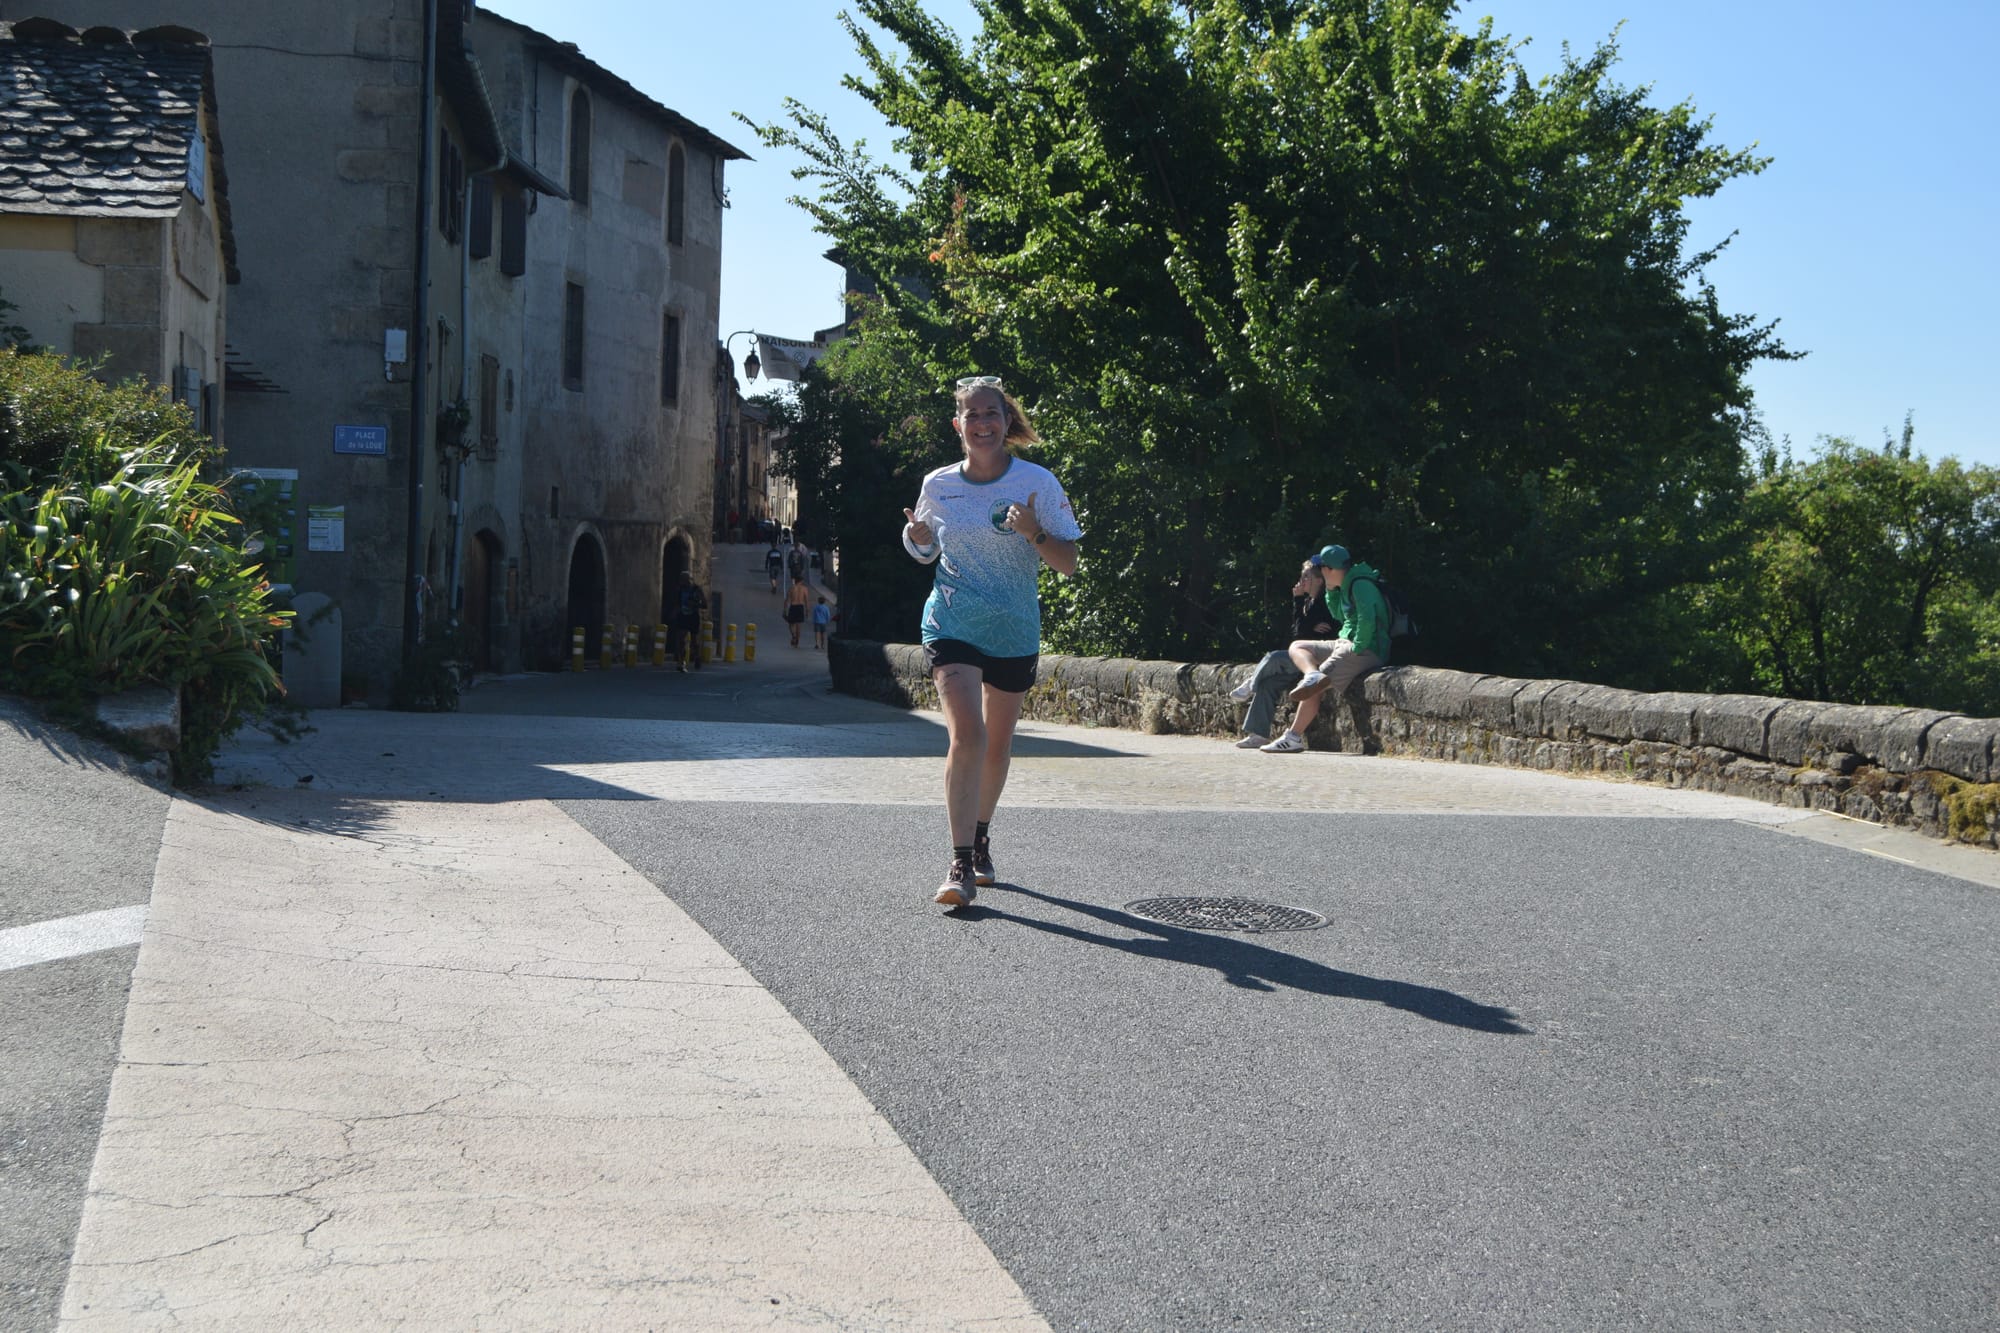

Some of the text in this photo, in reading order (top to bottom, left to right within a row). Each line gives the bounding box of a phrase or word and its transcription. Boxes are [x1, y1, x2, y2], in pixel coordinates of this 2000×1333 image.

[760, 336, 806, 348] MAISON
[355, 431, 376, 439] PLACE
[365, 441, 382, 450] LOUE
